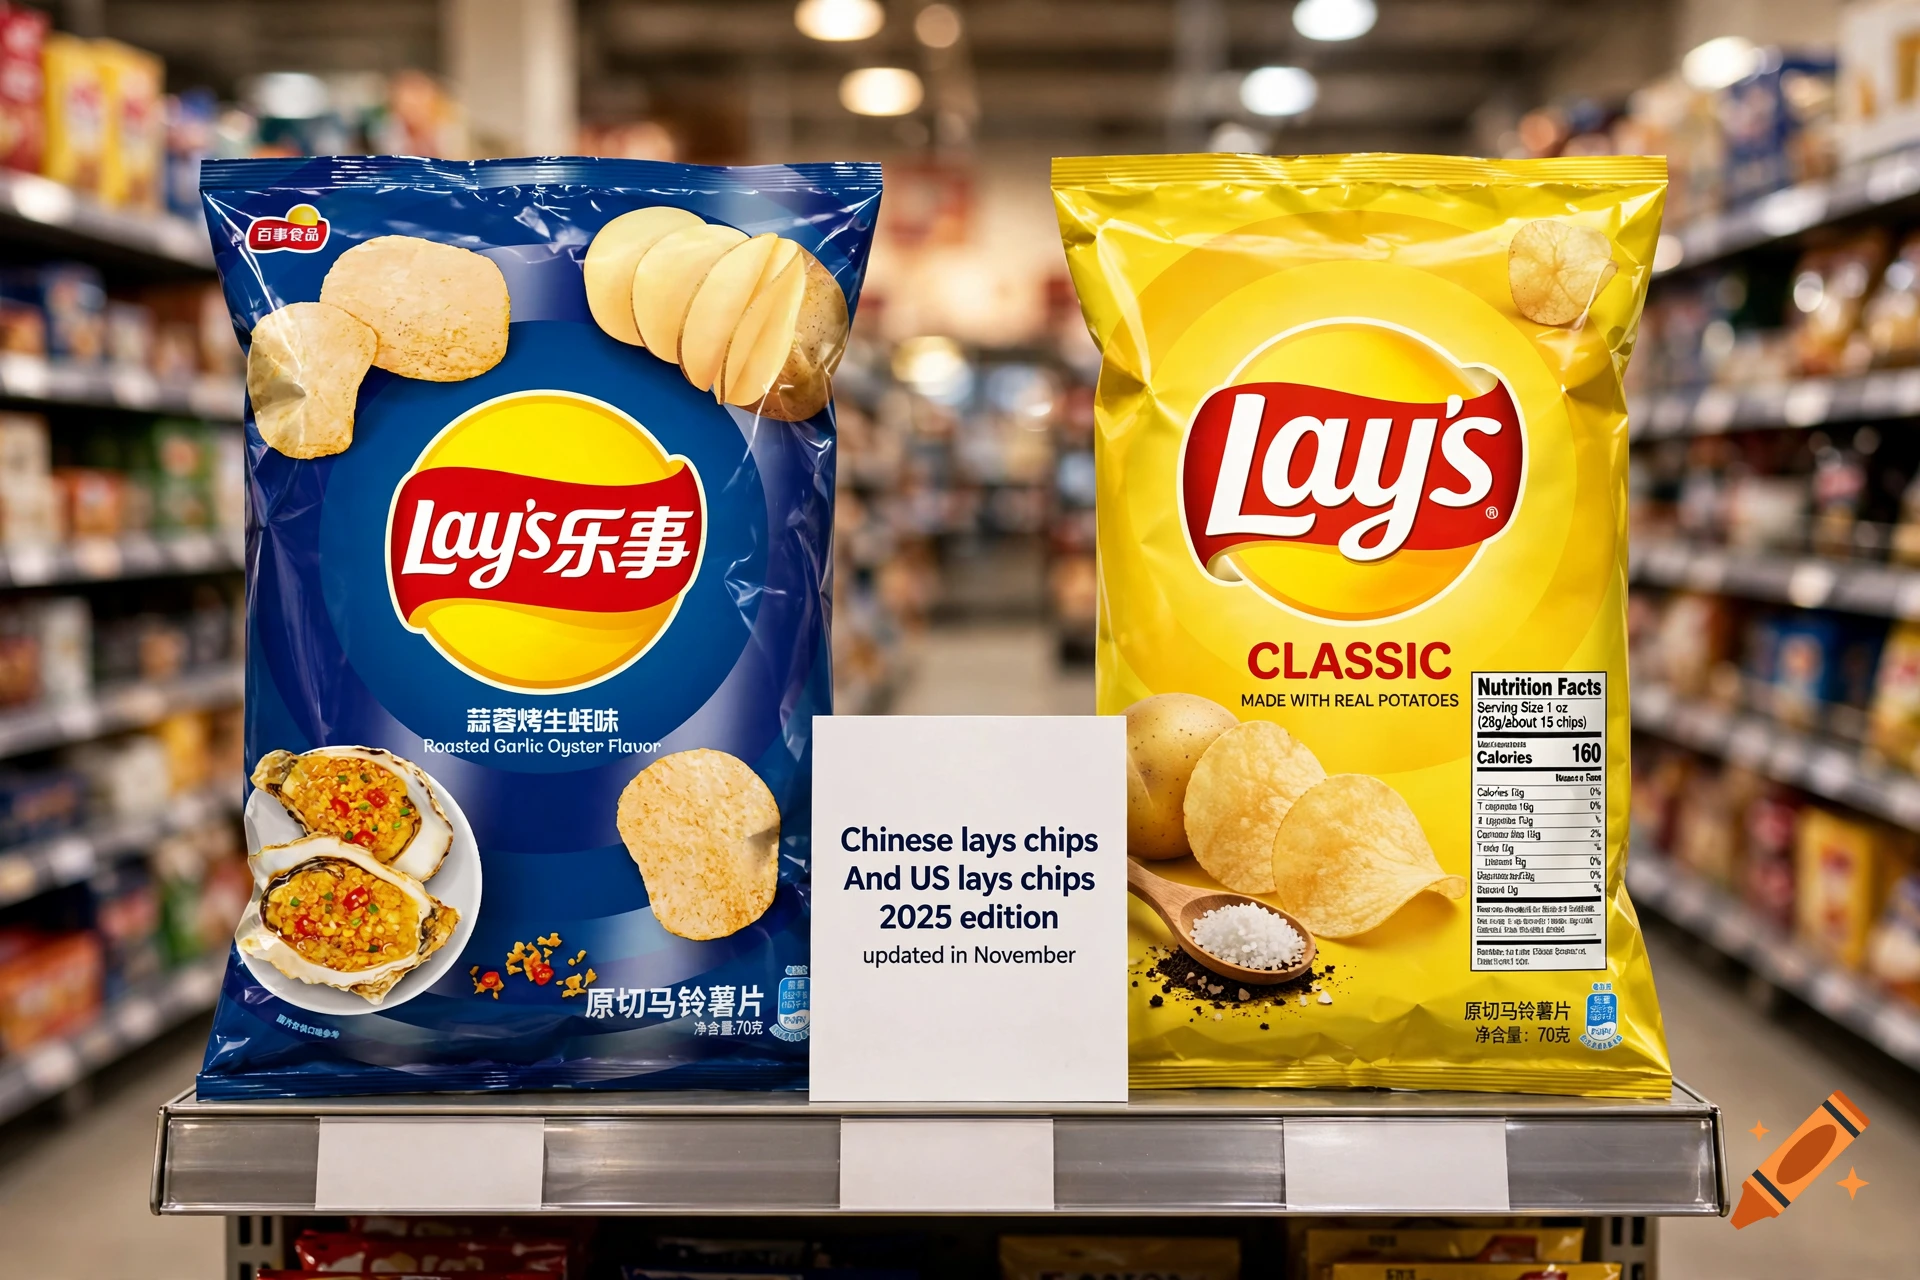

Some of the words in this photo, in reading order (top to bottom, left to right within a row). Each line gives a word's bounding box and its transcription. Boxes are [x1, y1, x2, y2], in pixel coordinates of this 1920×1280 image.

[1205, 394, 1503, 562] Lay's
[1248, 642, 1451, 679] CLASSIC
[1478, 677, 1552, 695] Nutrition
[1558, 678, 1601, 695] Facts
[1242, 694, 1285, 707] MADE
[1291, 694, 1329, 707] WITH
[1335, 694, 1374, 707] REAL
[1379, 694, 1458, 707] POTATOES
[1477, 702, 1518, 716] Serving
[1521, 702, 1543, 713] Size
[1546, 702, 1553, 713] 1
[1555, 704, 1568, 714] oz
[467, 708, 618, 732] 蒜蓉烤生蚝味
[1478, 715, 1537, 730] (28g/about
[1541, 716, 1553, 728] 15
[1557, 716, 1586, 730] chips)
[423, 738, 490, 754] Roasted
[494, 738, 543, 753] Garlic
[548, 739, 603, 757] Oyster
[608, 738, 662, 754] Flavor
[1477, 750, 1532, 764] Calories
[1573, 743, 1601, 763] 160
[841, 826, 953, 852] Chinese
[962, 826, 1016, 858] lays
[1024, 826, 1098, 858] chips
[844, 865, 900, 890] And
[911, 865, 949, 890] US
[959, 865, 1012, 896] lays
[1021, 865, 1095, 897] chips
[880, 904, 951, 929] 2025
[961, 904, 1057, 929] edition
[864, 945, 943, 968] updated
[951, 946, 966, 963] in
[975, 946, 1076, 963] November
[584, 984, 763, 1018] 原切马铃薯片
[1465, 1001, 1570, 1020] 原切马铃薯片
